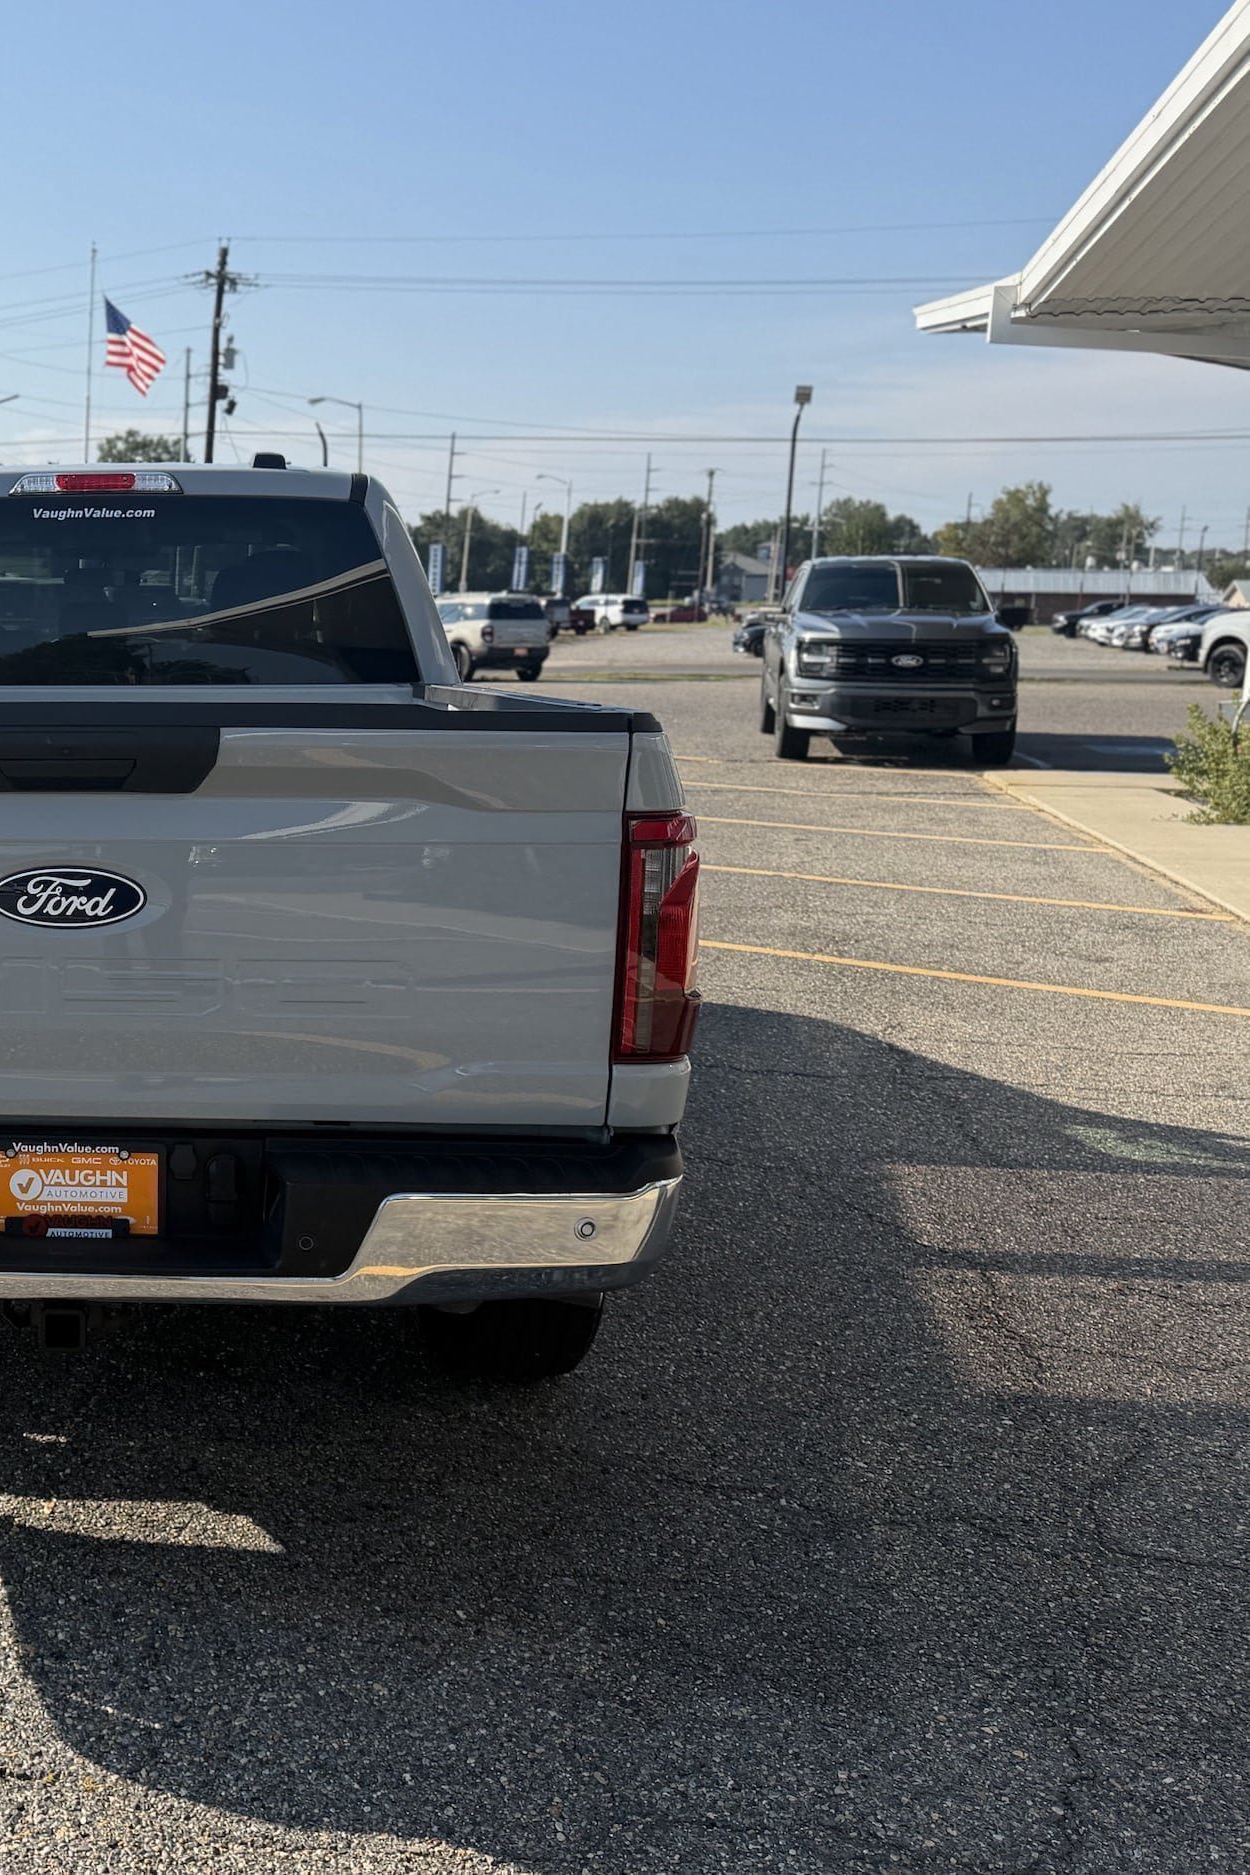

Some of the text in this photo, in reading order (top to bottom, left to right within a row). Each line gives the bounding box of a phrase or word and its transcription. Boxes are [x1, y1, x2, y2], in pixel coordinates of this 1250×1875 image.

[32, 508, 156, 521] VaughnValue.com
[16, 876, 117, 916] Ford
[12, 1142, 119, 1154] VaughnValue.com
[39, 1169, 128, 1186] VAUGHN
[45, 1190, 125, 1199] AUTOMOTIVE
[16, 1202, 122, 1214] VaughnValue.com
